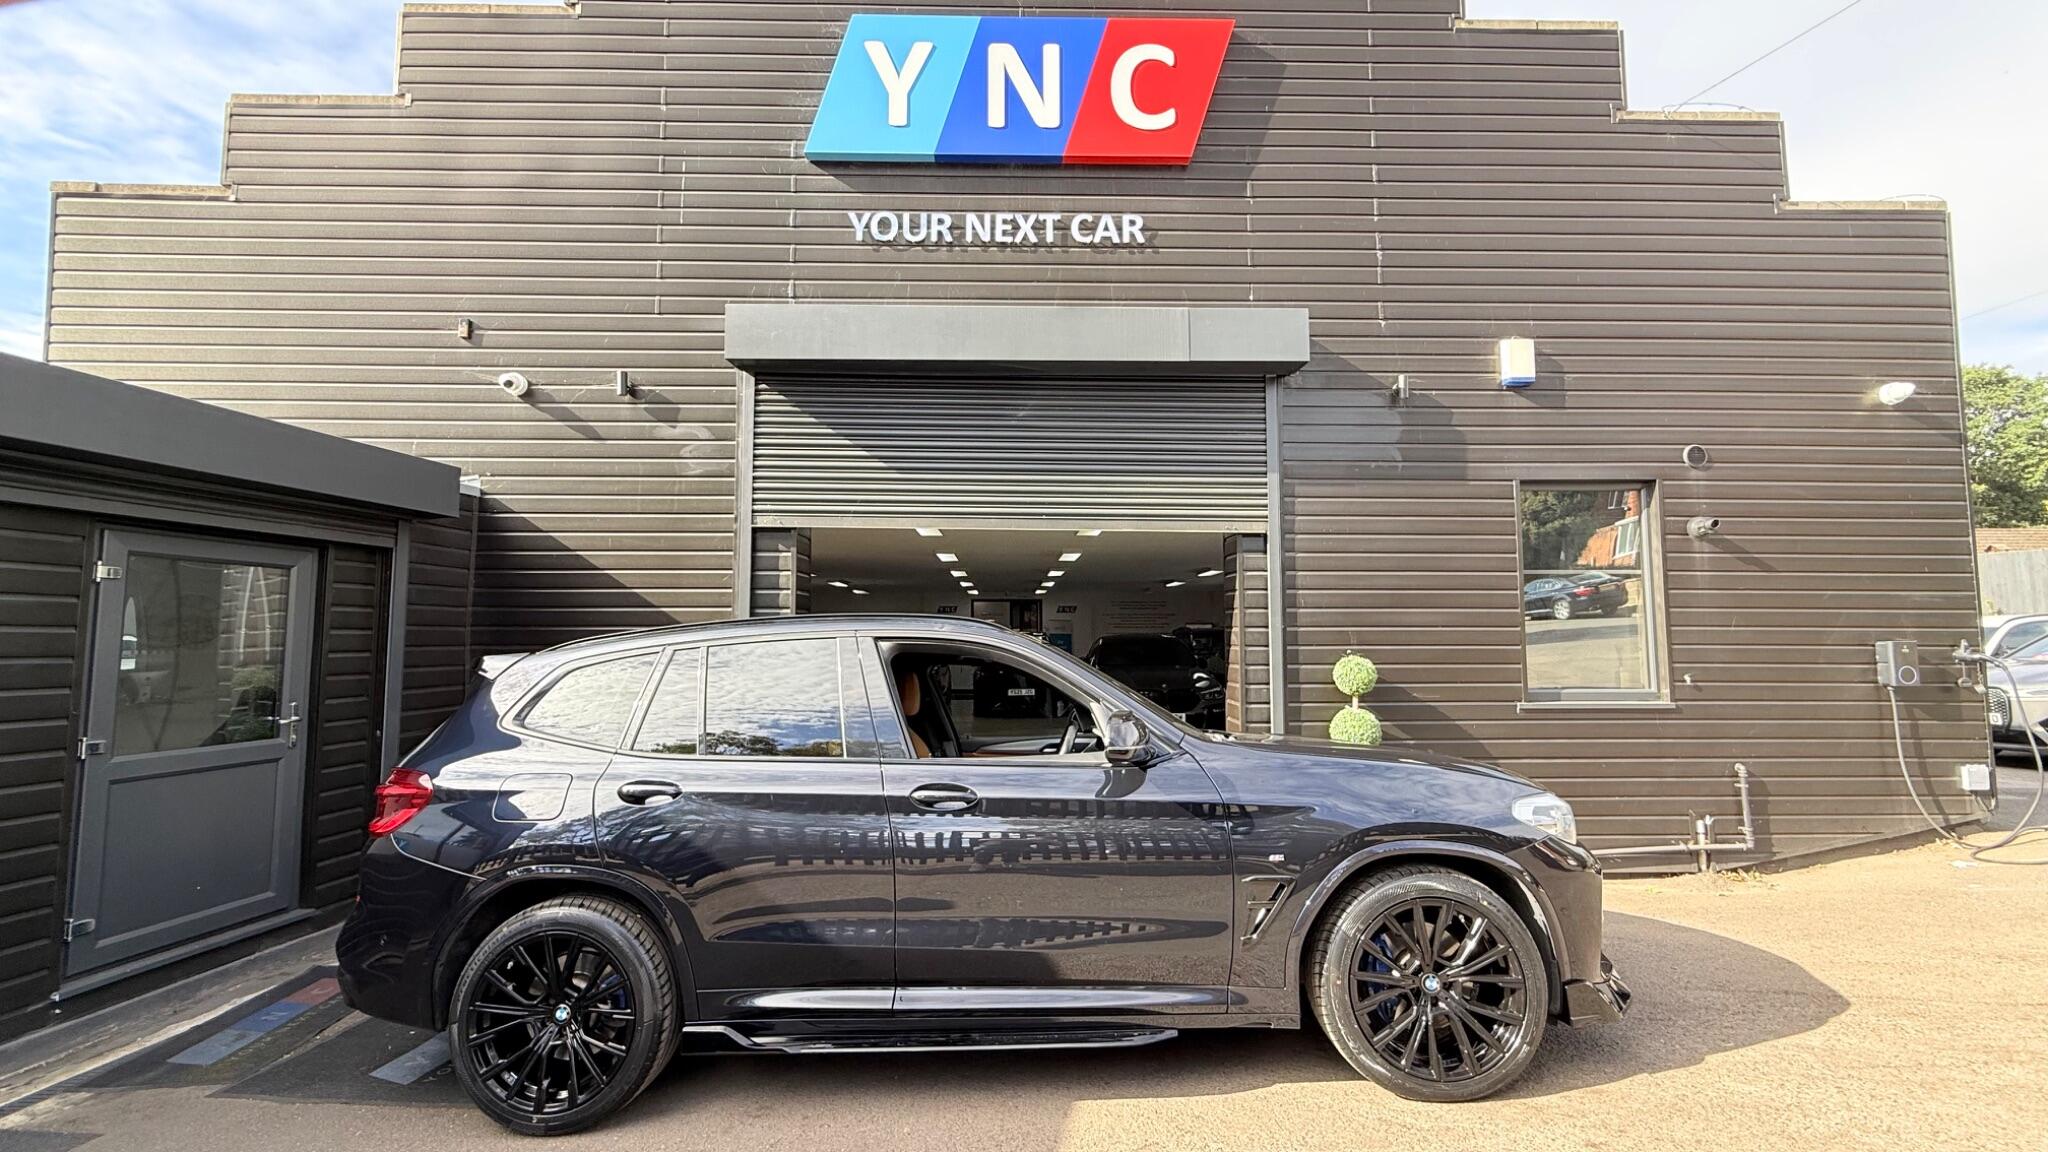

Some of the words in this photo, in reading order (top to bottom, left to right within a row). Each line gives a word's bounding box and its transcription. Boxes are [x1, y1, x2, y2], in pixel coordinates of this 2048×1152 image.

[863, 40, 1177, 131] YNC
[847, 211, 953, 243] YOUR
[965, 212, 1061, 243] NEXT
[1070, 213, 1146, 244] CAR
